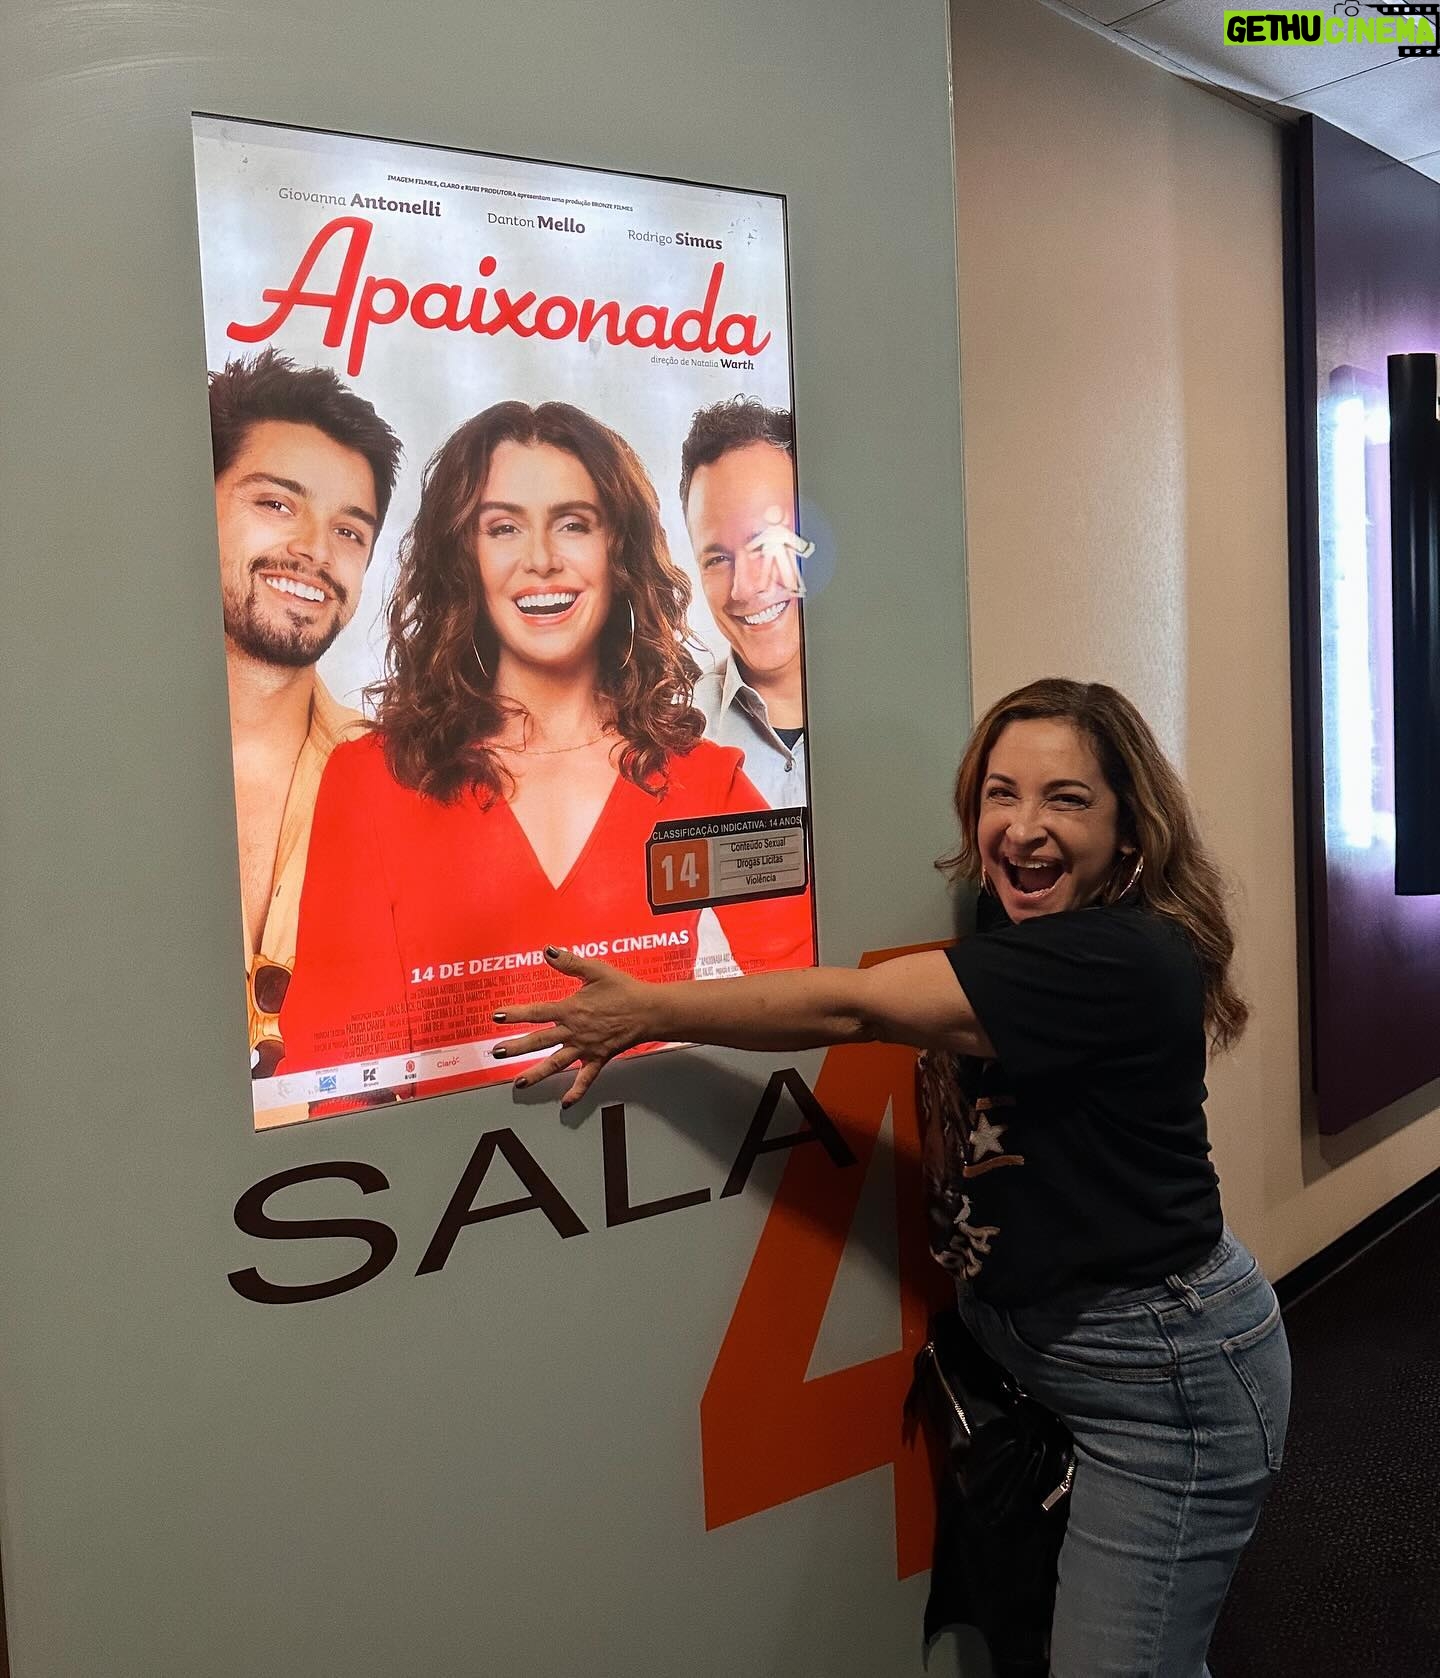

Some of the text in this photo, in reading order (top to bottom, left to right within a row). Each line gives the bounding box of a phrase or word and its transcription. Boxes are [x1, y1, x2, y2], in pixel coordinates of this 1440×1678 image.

[278, 187, 441, 217] Giovanna Antonelli
[387, 174, 414, 184] IMAGEM
[415, 178, 439, 188] FILMES,
[440, 182, 460, 190] CLARO
[480, 186, 517, 197] PRODUTORA
[551, 196, 565, 204] uma
[565, 198, 591, 207] produção
[591, 201, 613, 210] BRONZE
[613, 204, 634, 212] FILMES
[487, 212, 586, 234] Danton Mello
[627, 229, 723, 250] Rodrigo Simas
[226, 216, 771, 378] Apaixonada
[650, 355, 755, 370] direção de Natalia Warth
[652, 815, 802, 842] CLASSIFICAÇÃO INDICATIVA: 14 ANOS
[730, 837, 786, 853] Conteúdo Sexual
[661, 852, 700, 892] 14
[737, 857, 760, 869] Drogas
[745, 873, 777, 886] Violência
[411, 966, 435, 984] 14
[438, 960, 464, 979] DE
[572, 940, 608, 960] NOS
[611, 929, 690, 955] CINEMAS
[227, 1067, 858, 1305] SALA
[700, 939, 956, 1582] 4
